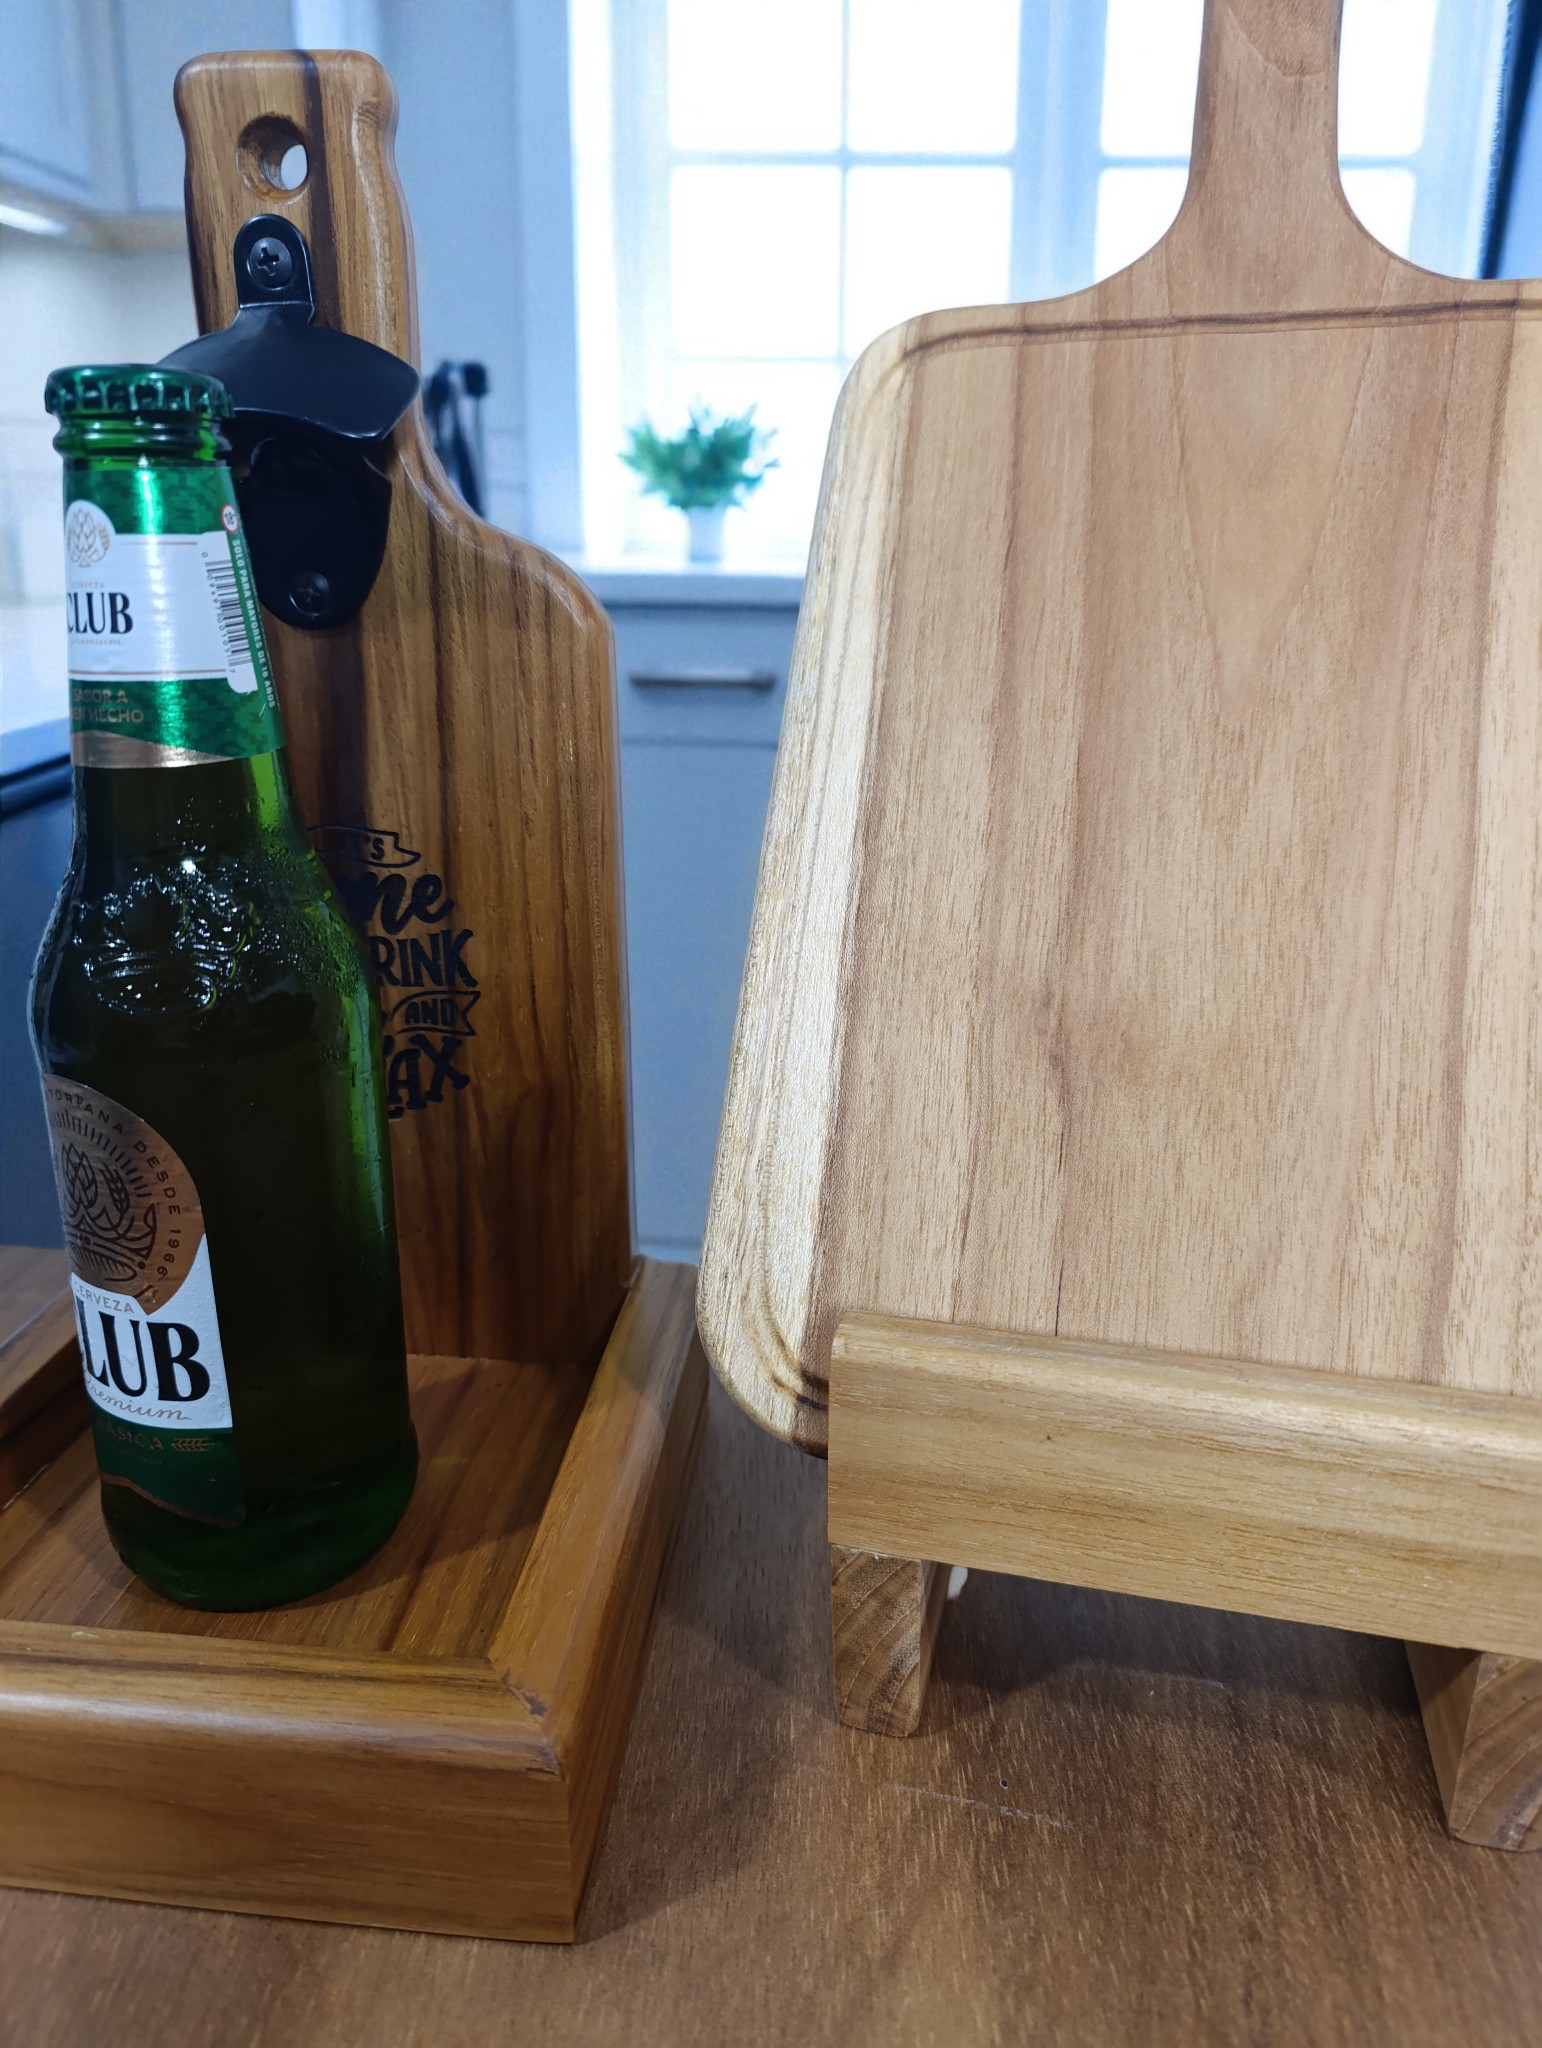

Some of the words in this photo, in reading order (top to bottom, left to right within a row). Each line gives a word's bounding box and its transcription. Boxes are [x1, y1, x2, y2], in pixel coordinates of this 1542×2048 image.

[67, 591, 134, 635] CLUB
[231, 539, 244, 567] SOLO
[239, 570, 250, 598] PARA
[246, 600, 263, 649] MAYORES
[258, 651, 266, 664] DE
[117, 689, 129, 703] A
[368, 928, 478, 988] RINK
[404, 998, 459, 1026] AND
[133, 1140, 182, 1216] DESDE
[155, 1227, 182, 1278] 1966
[73, 1281, 135, 1314] CERVEZA
[76, 1296, 211, 1402] LUB
